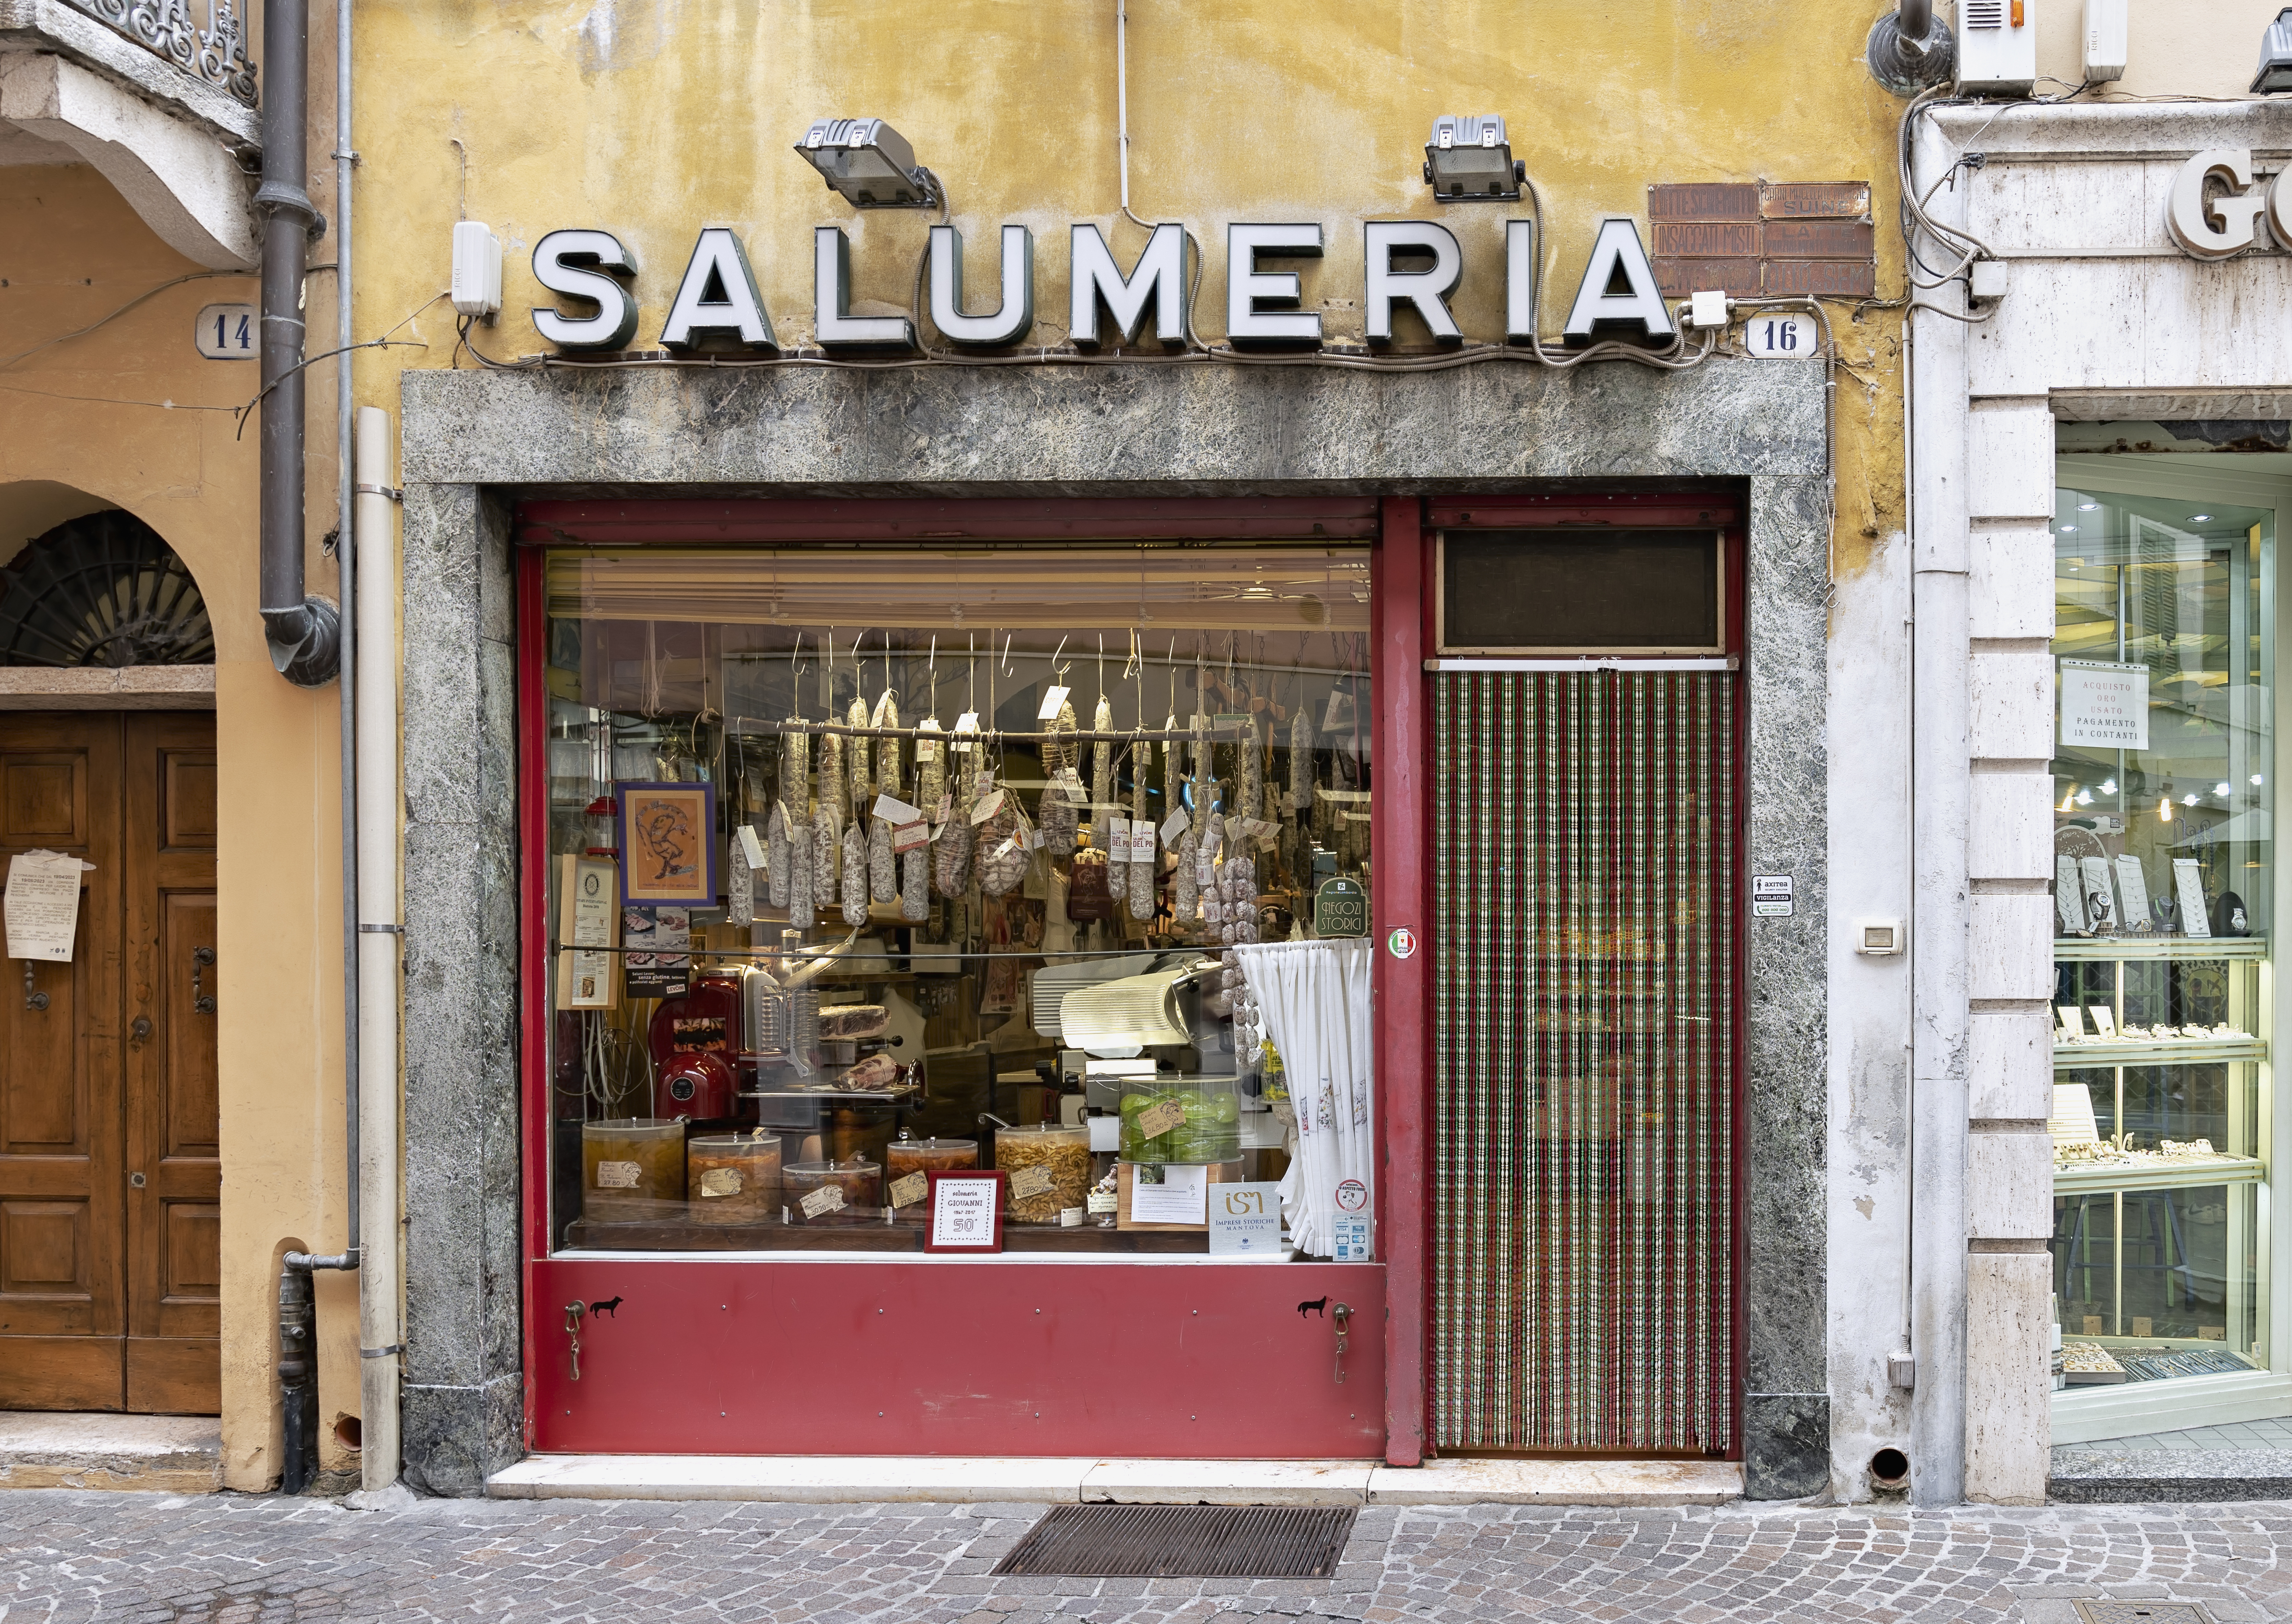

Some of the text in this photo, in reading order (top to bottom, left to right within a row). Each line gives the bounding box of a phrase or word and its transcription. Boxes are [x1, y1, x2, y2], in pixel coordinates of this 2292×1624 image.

[1765, 187, 1786, 201] CARNI
[1784, 201, 1848, 214] SUINE
[1782, 226, 1854, 238] LATTE
[1658, 226, 1754, 253] INSACCATI MISTI
[532, 218, 1676, 350] SALUMERIA
[1768, 264, 1811, 291] OLIO
[214, 314, 251, 349] 14
[1765, 321, 1796, 350] 16
[2083, 682, 2130, 691] ACQUISTO
[2077, 717, 2135, 727] PAGAMENTO
[2091, 730, 2137, 739] CONTANTI
[1322, 902, 1360, 916] NEGOZI
[1321, 918, 1360, 930] STORICI
[1141, 1111, 1156, 1120] Cedro
[1141, 1117, 1157, 1126] Candito
